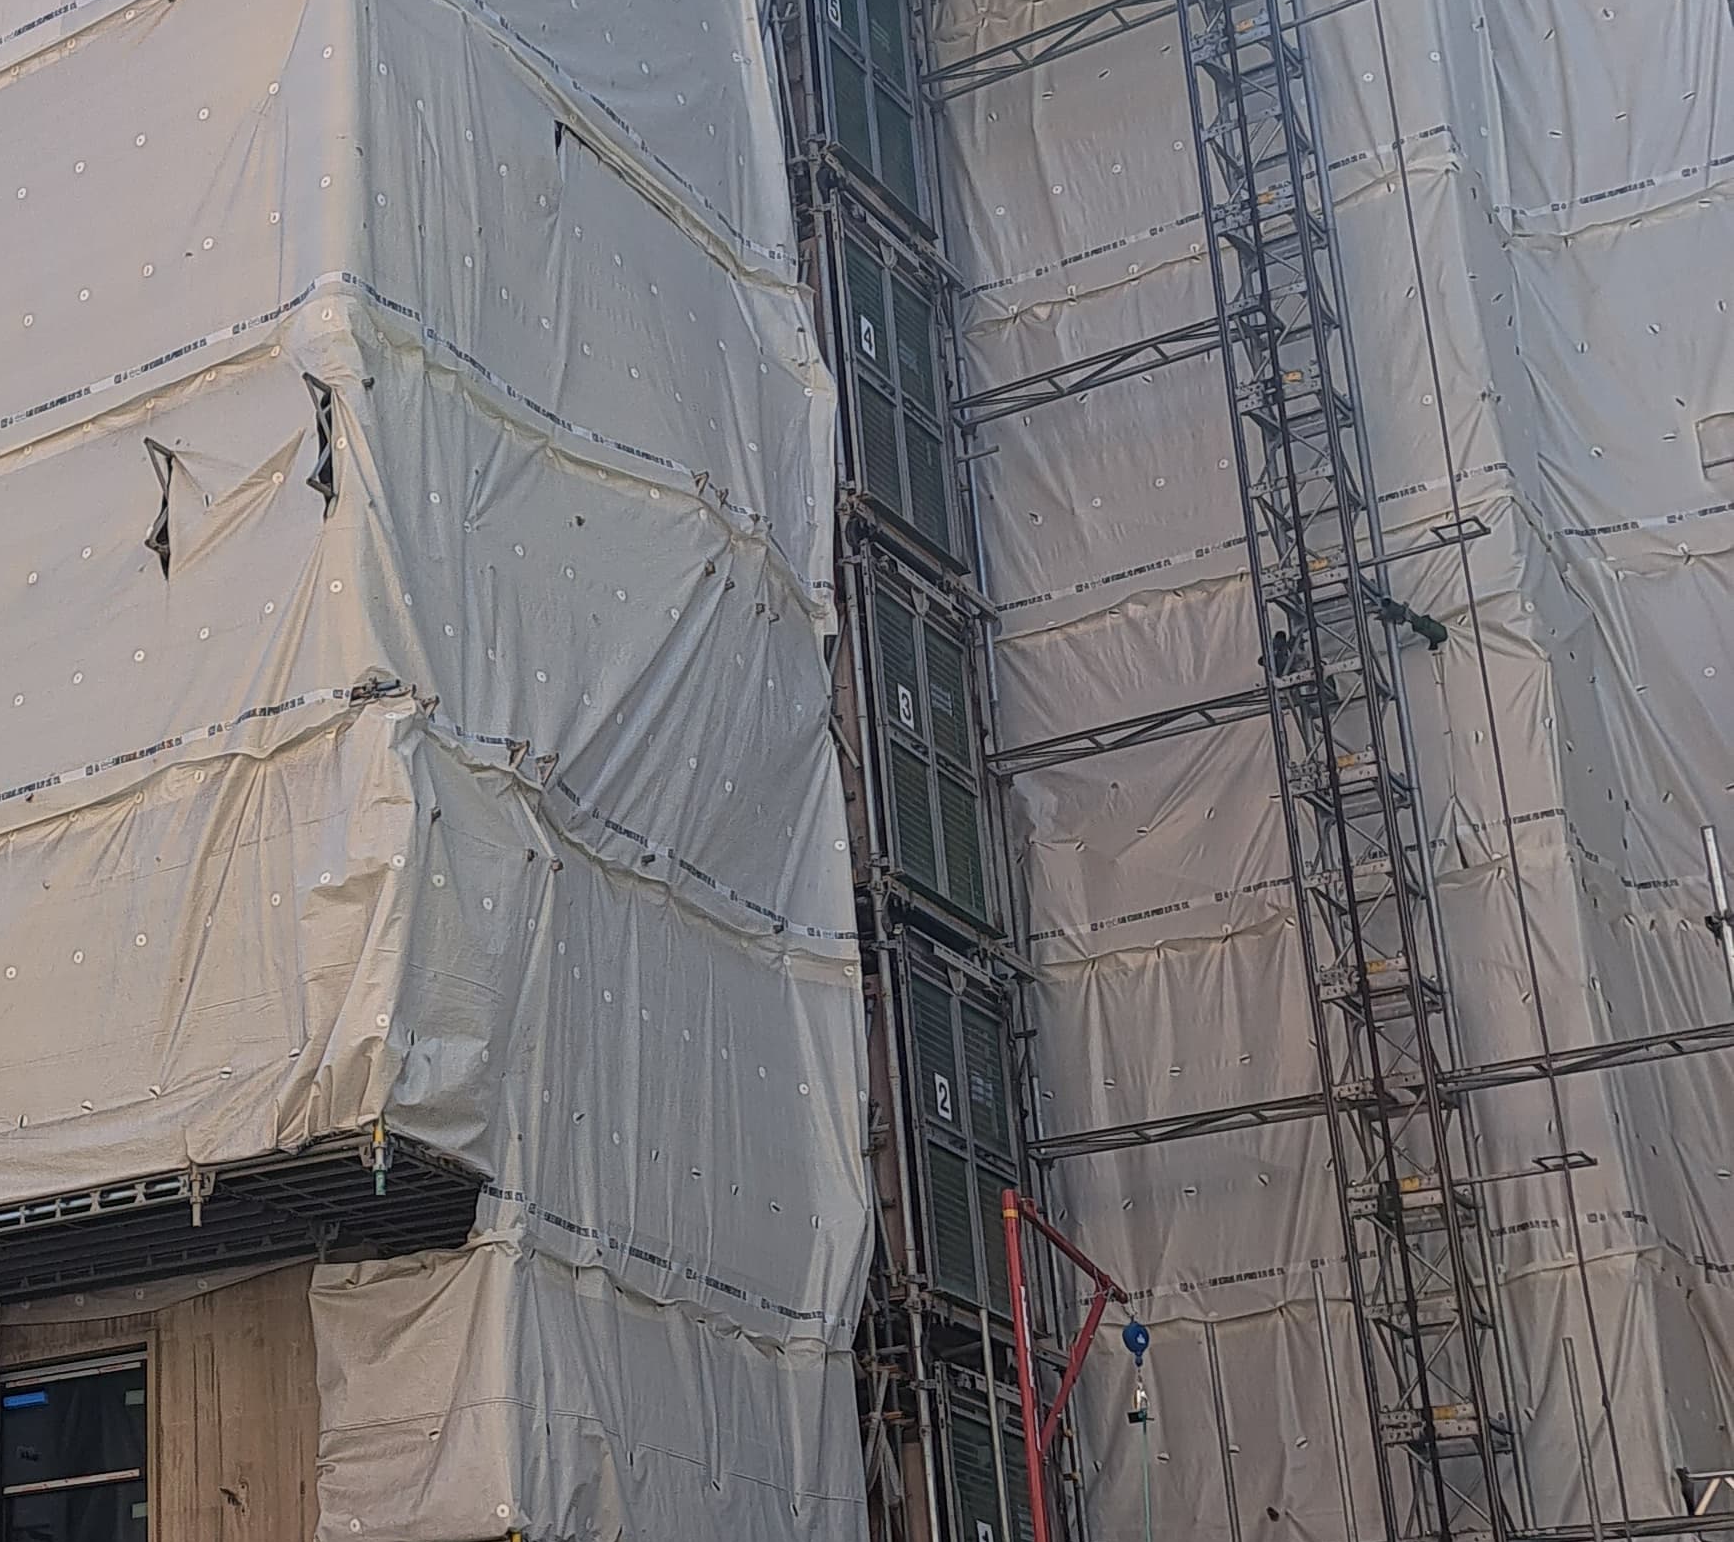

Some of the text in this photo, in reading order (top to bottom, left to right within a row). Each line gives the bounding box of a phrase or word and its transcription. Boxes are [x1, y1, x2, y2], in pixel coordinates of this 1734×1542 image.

[863, 326, 873, 352] 4
[901, 692, 912, 721] 3
[938, 1082, 950, 1114] 2
